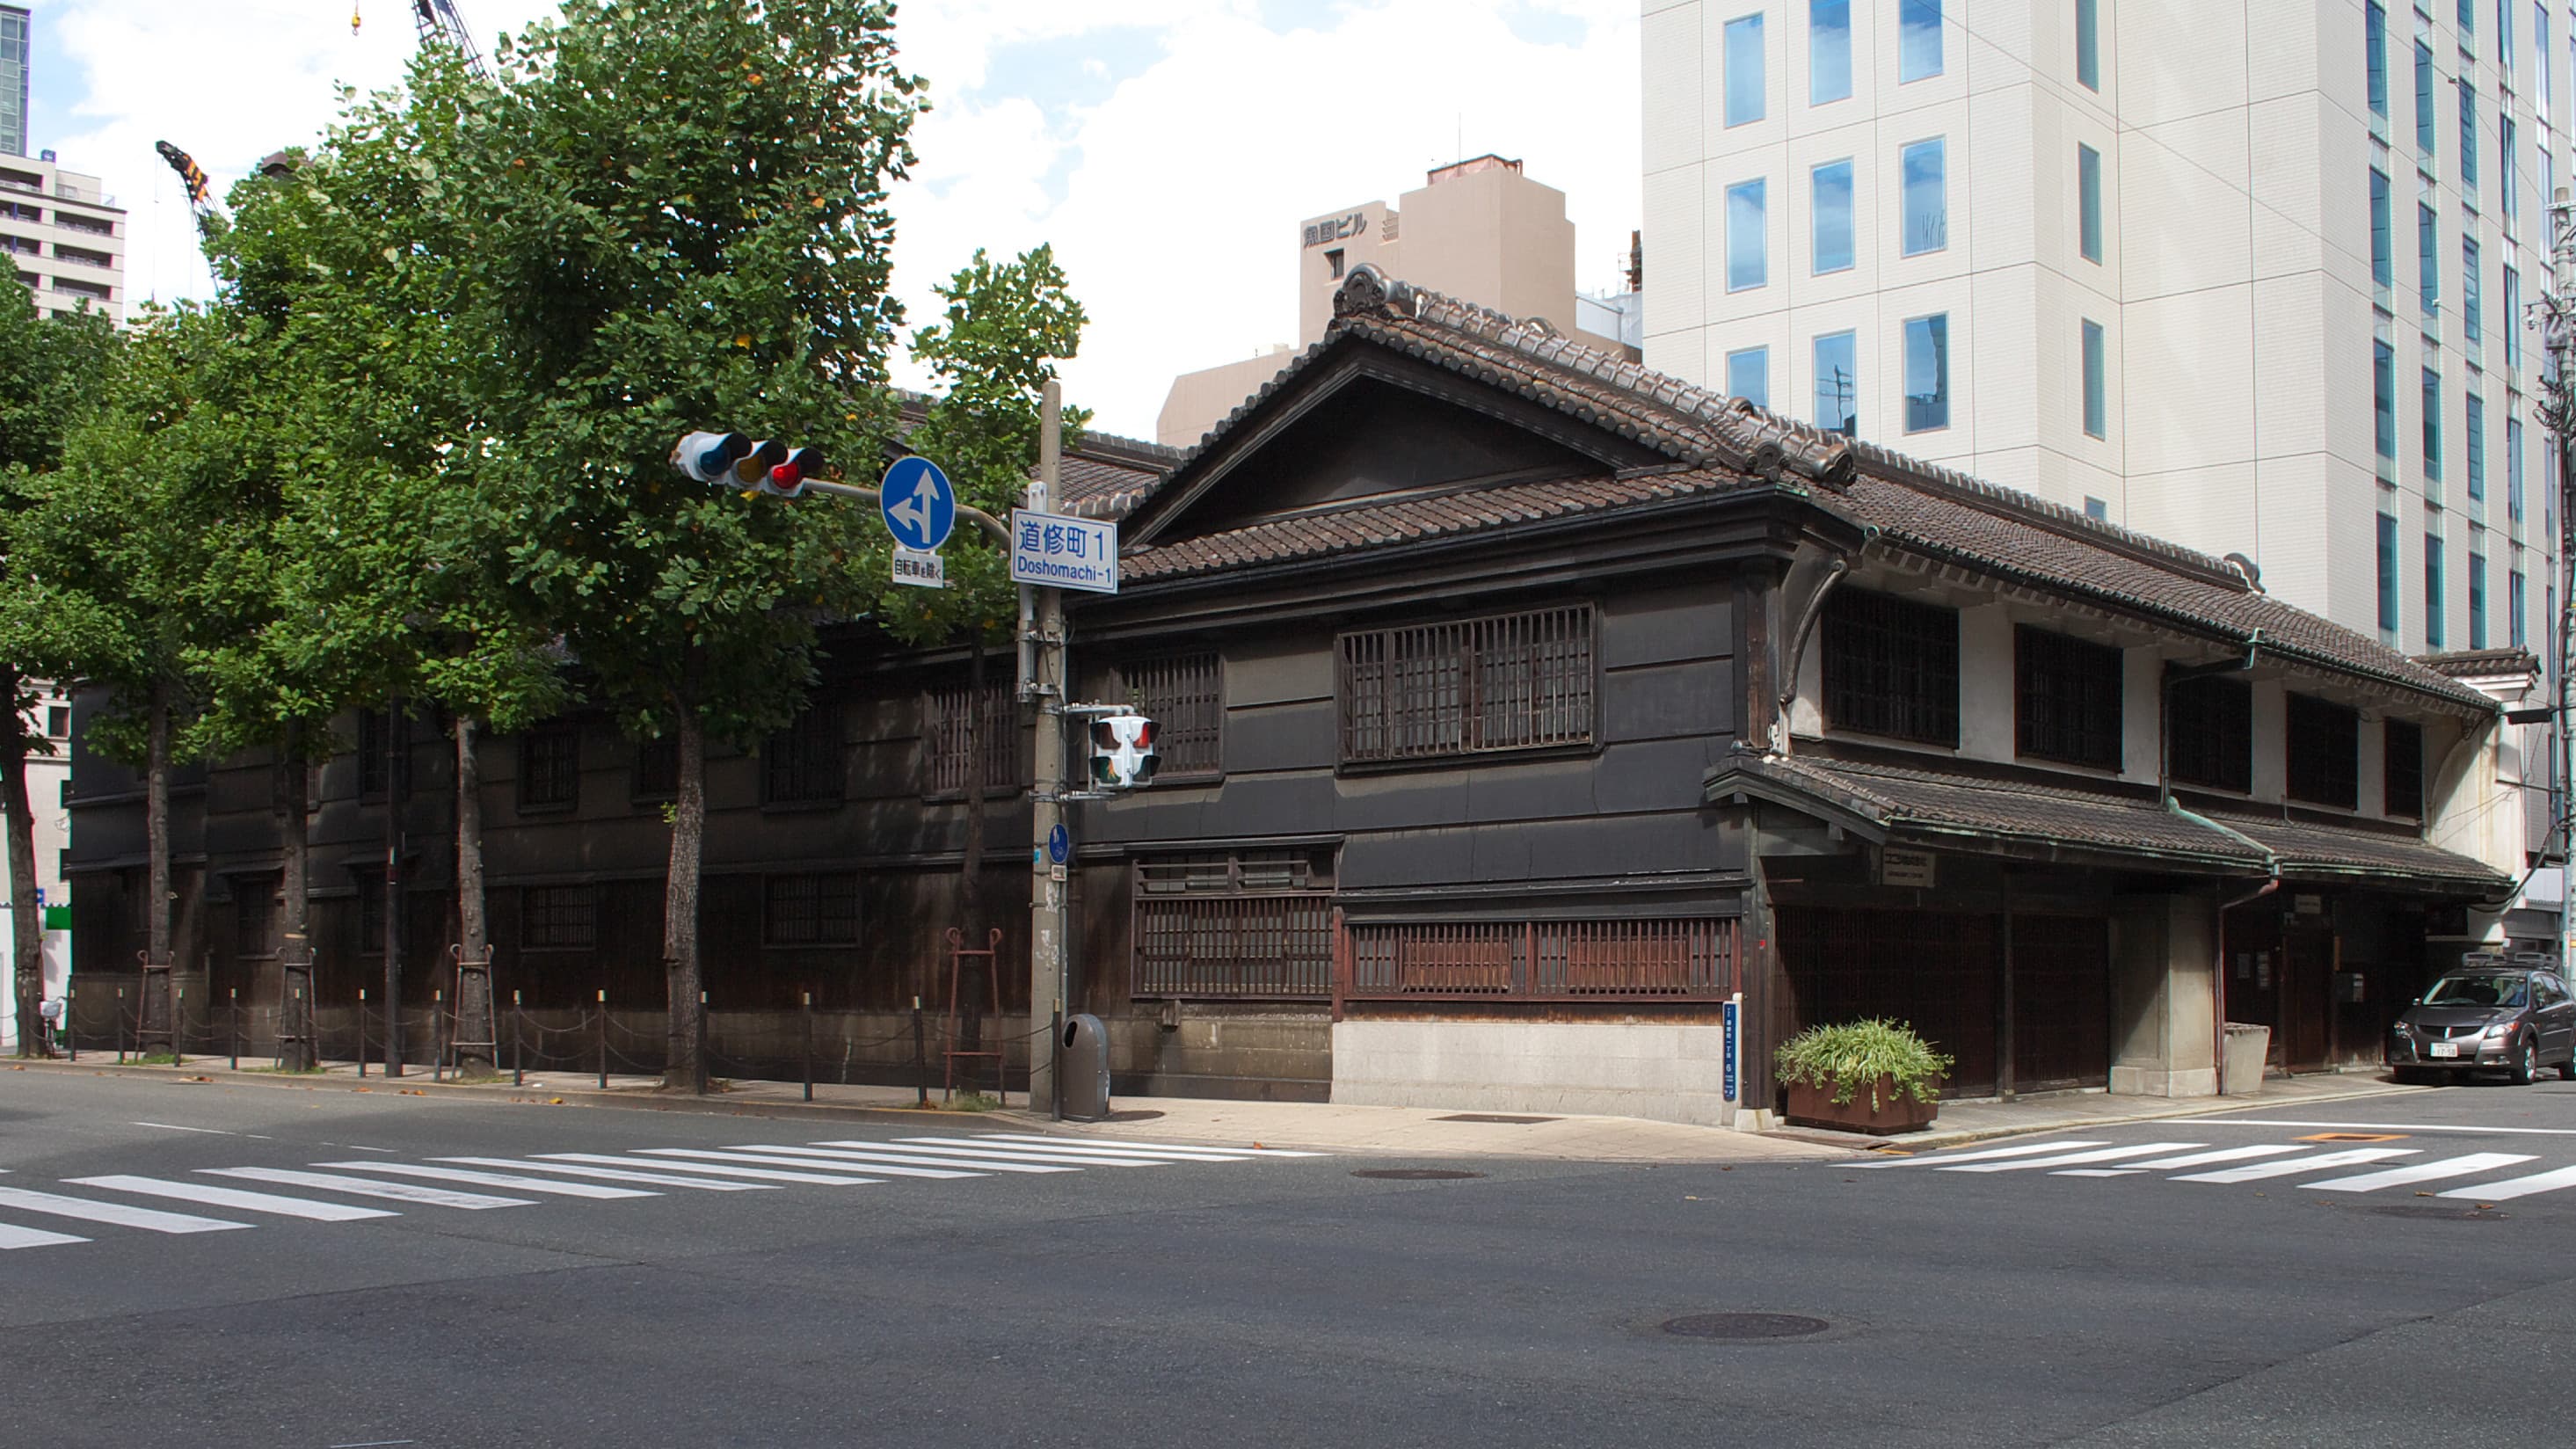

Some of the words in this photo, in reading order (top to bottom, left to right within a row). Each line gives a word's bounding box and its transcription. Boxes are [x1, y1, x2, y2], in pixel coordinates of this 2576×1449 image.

[1304, 213, 1367, 249] 魚国ビル
[895, 558, 941, 579] 自転車を除く
[1018, 556, 1110, 583] Doshomachi-1
